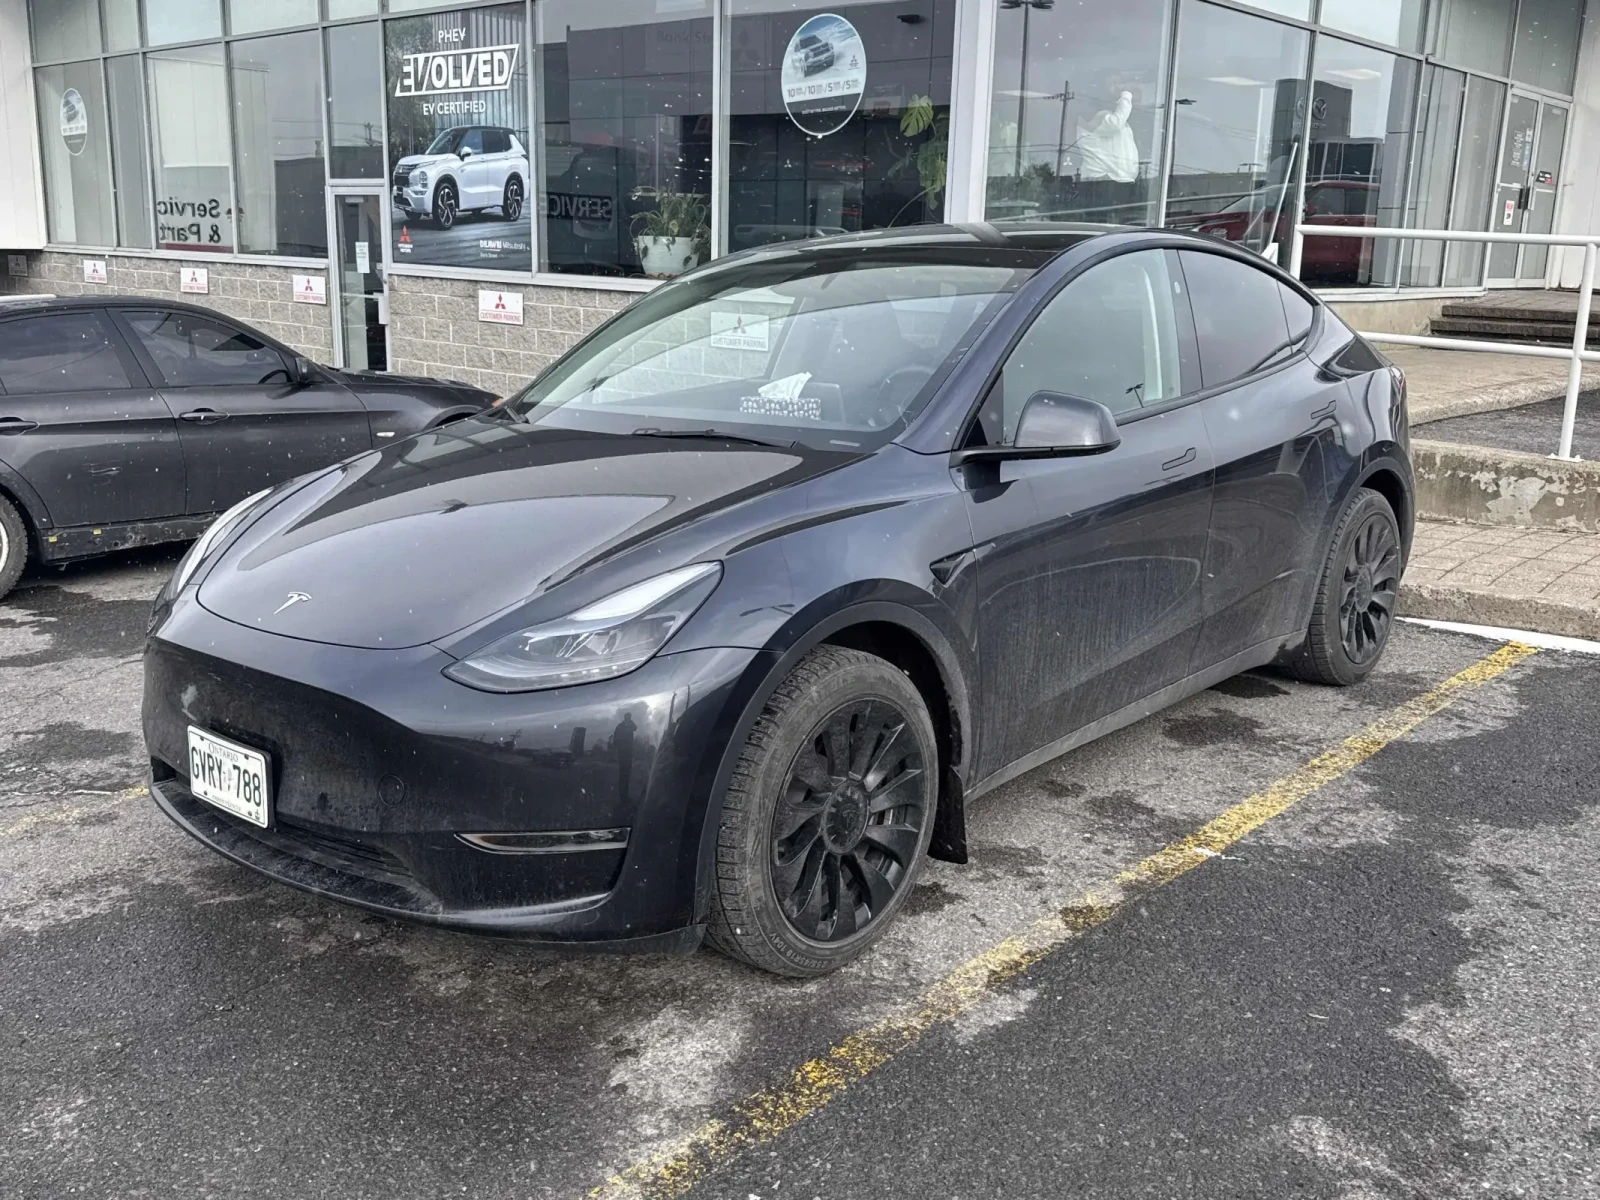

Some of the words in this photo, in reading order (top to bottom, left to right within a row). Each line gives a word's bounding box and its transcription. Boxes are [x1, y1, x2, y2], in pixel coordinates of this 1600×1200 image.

[438, 27, 466, 43] PHEV
[401, 50, 511, 93] EVOLVED
[423, 103, 435, 116] EV
[436, 100, 486, 115] CERTIFIED
[208, 742, 239, 763] ONTARIO
[191, 746, 223, 791] GVRY
[232, 764, 262, 808] 788
